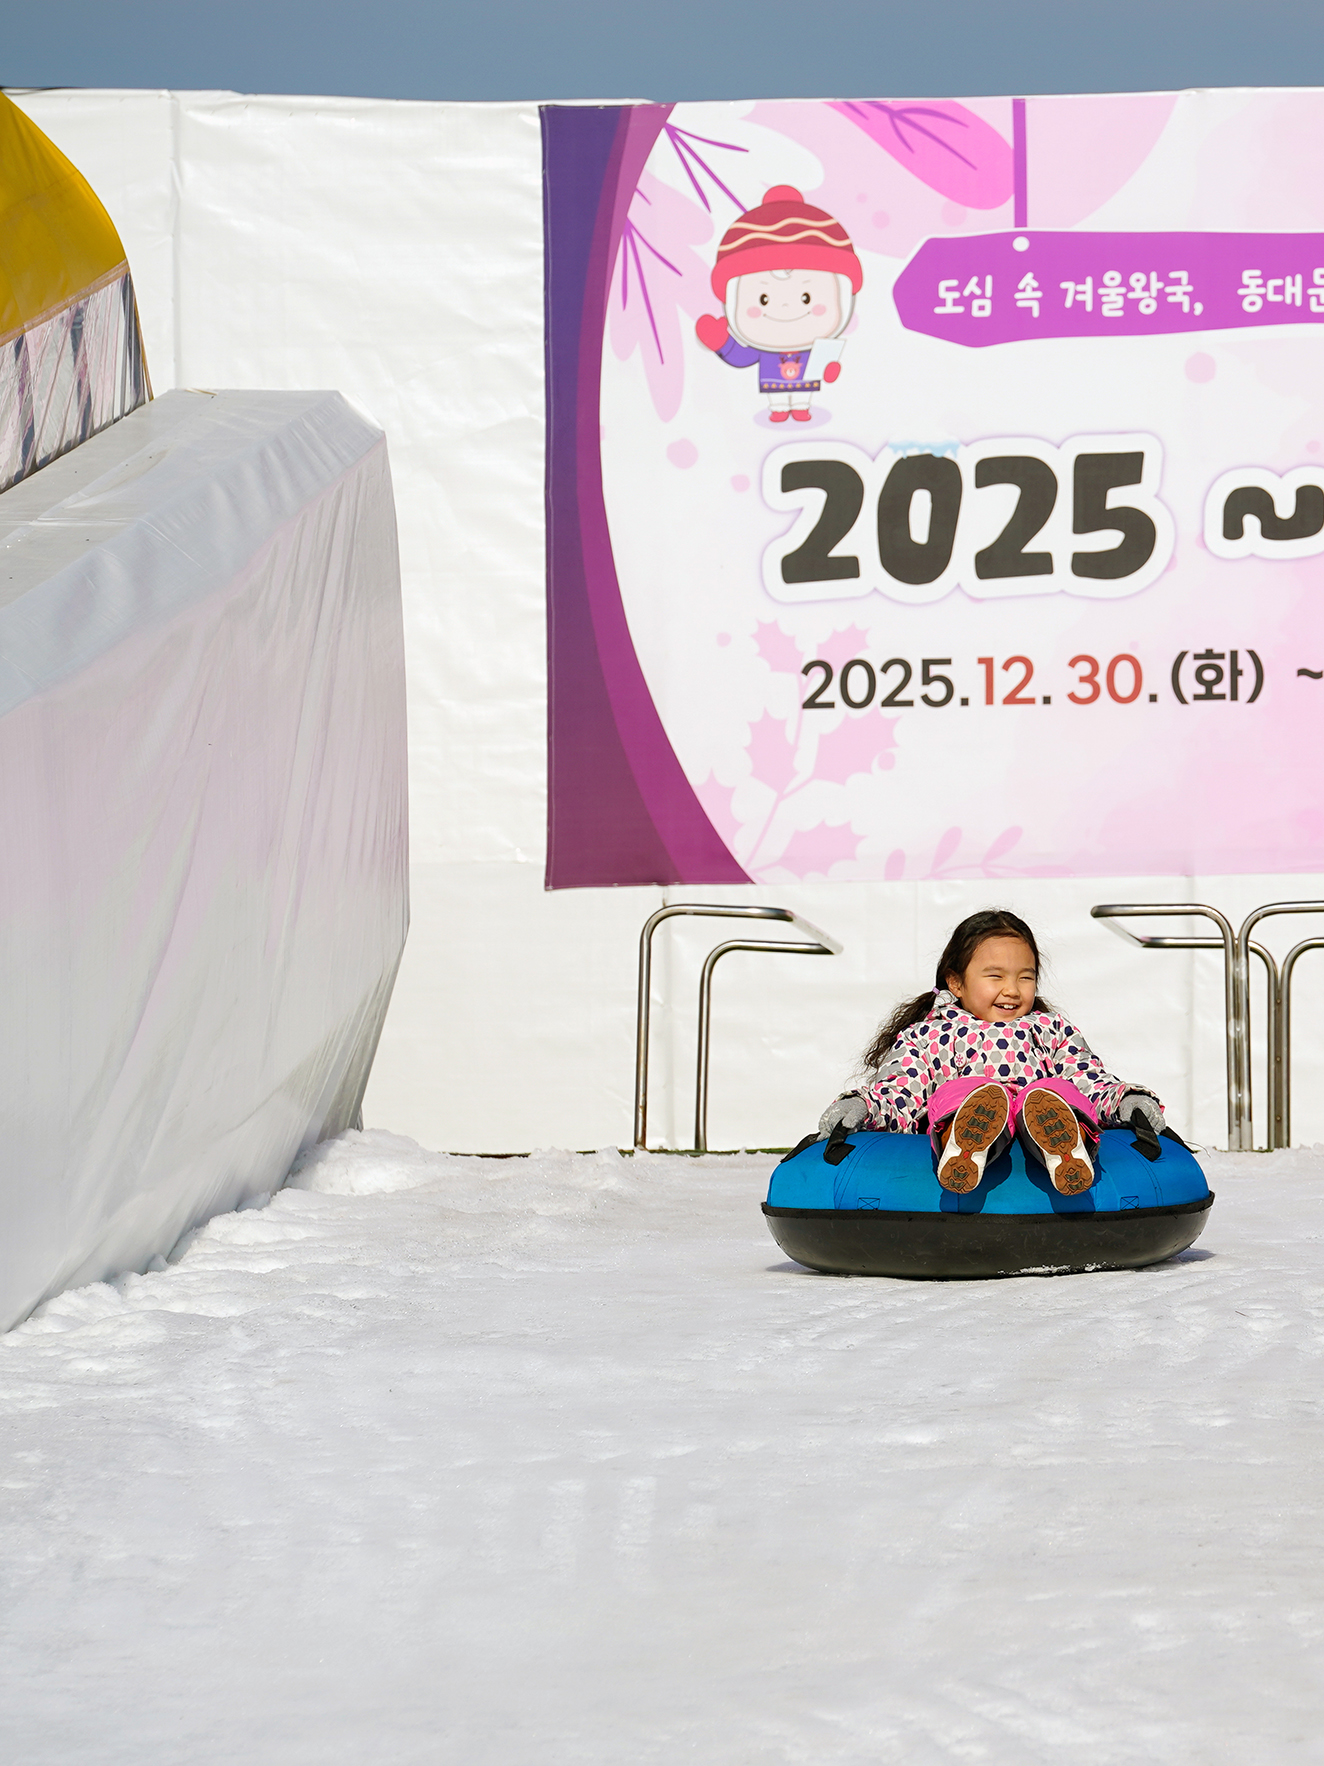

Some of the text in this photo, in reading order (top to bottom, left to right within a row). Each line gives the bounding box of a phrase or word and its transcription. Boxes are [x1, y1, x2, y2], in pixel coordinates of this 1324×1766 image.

[933, 274, 993, 318] 도심
[1013, 271, 1043, 318] 속
[1059, 270, 1204, 318] 겨울왕국,
[780, 450, 1158, 586] 2025
